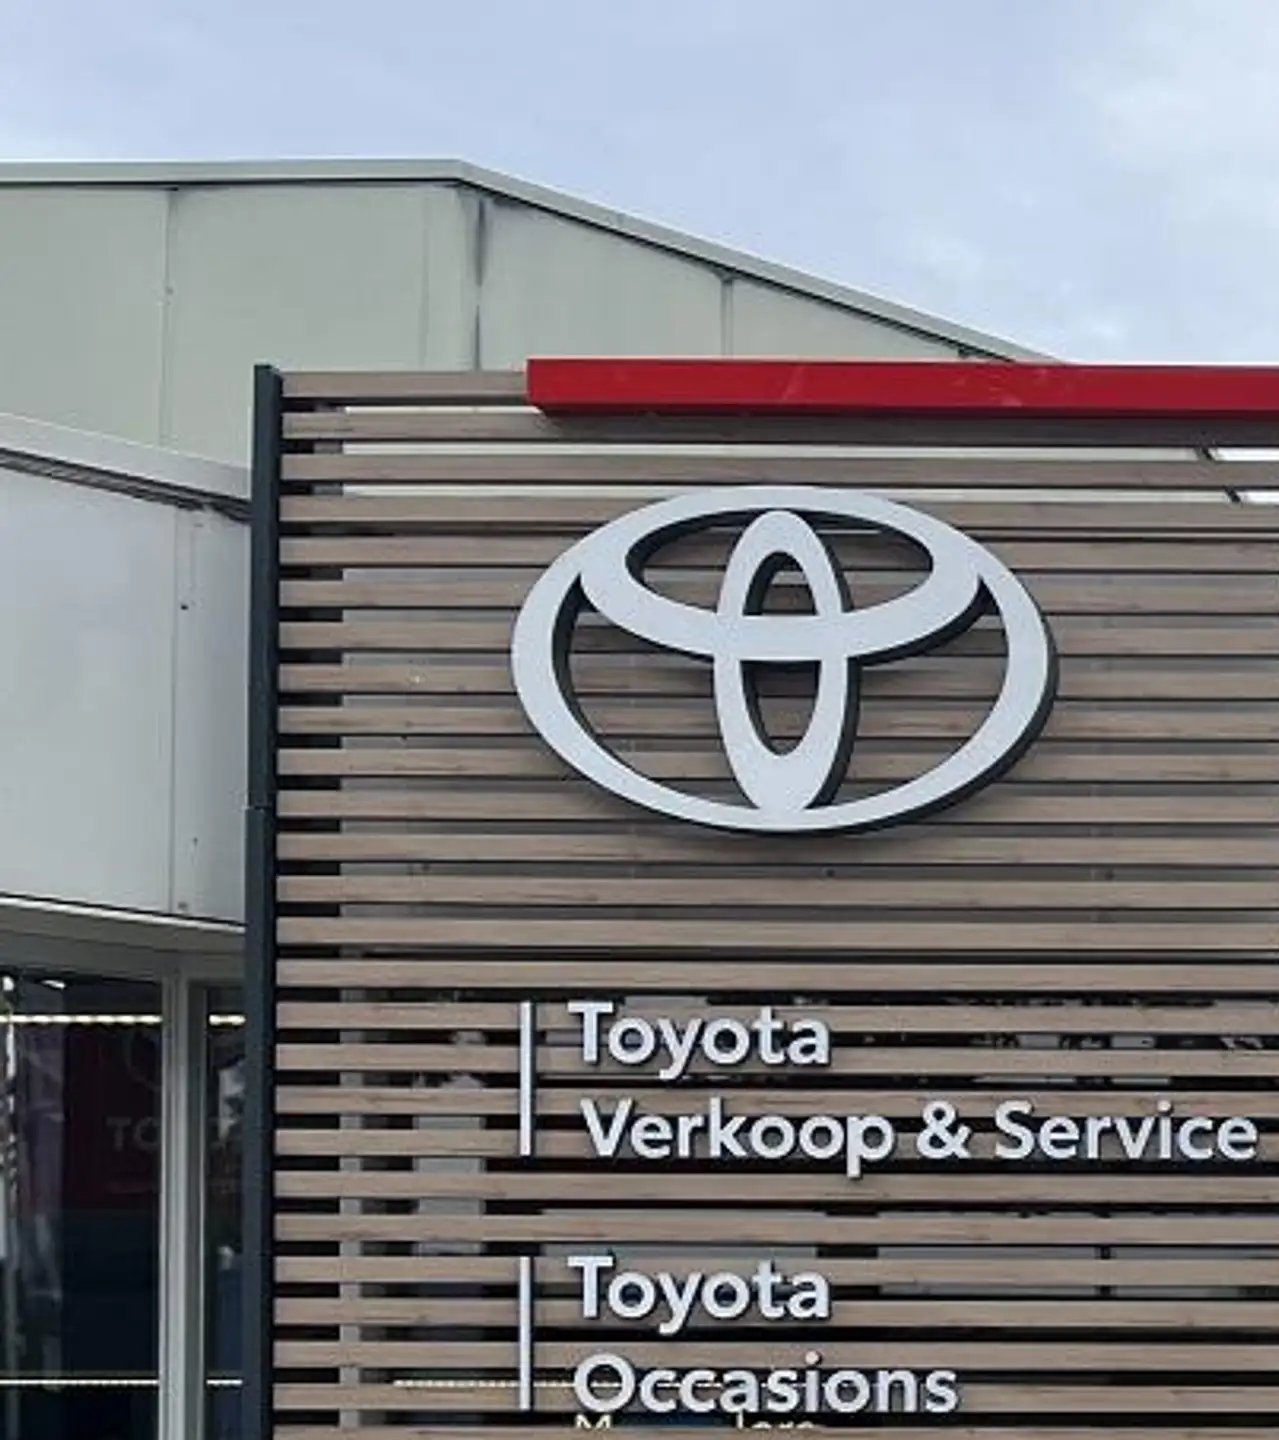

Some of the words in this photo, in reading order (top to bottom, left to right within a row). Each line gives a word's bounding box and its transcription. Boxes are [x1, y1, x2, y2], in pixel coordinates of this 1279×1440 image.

[567, 1002, 830, 1079] Toyota
[580, 1097, 895, 1178] Verkoop
[917, 1101, 972, 1159] &
[994, 1100, 1259, 1159] Service
[567, 1255, 831, 1334] Toyota
[573, 1351, 959, 1414] Occasions
